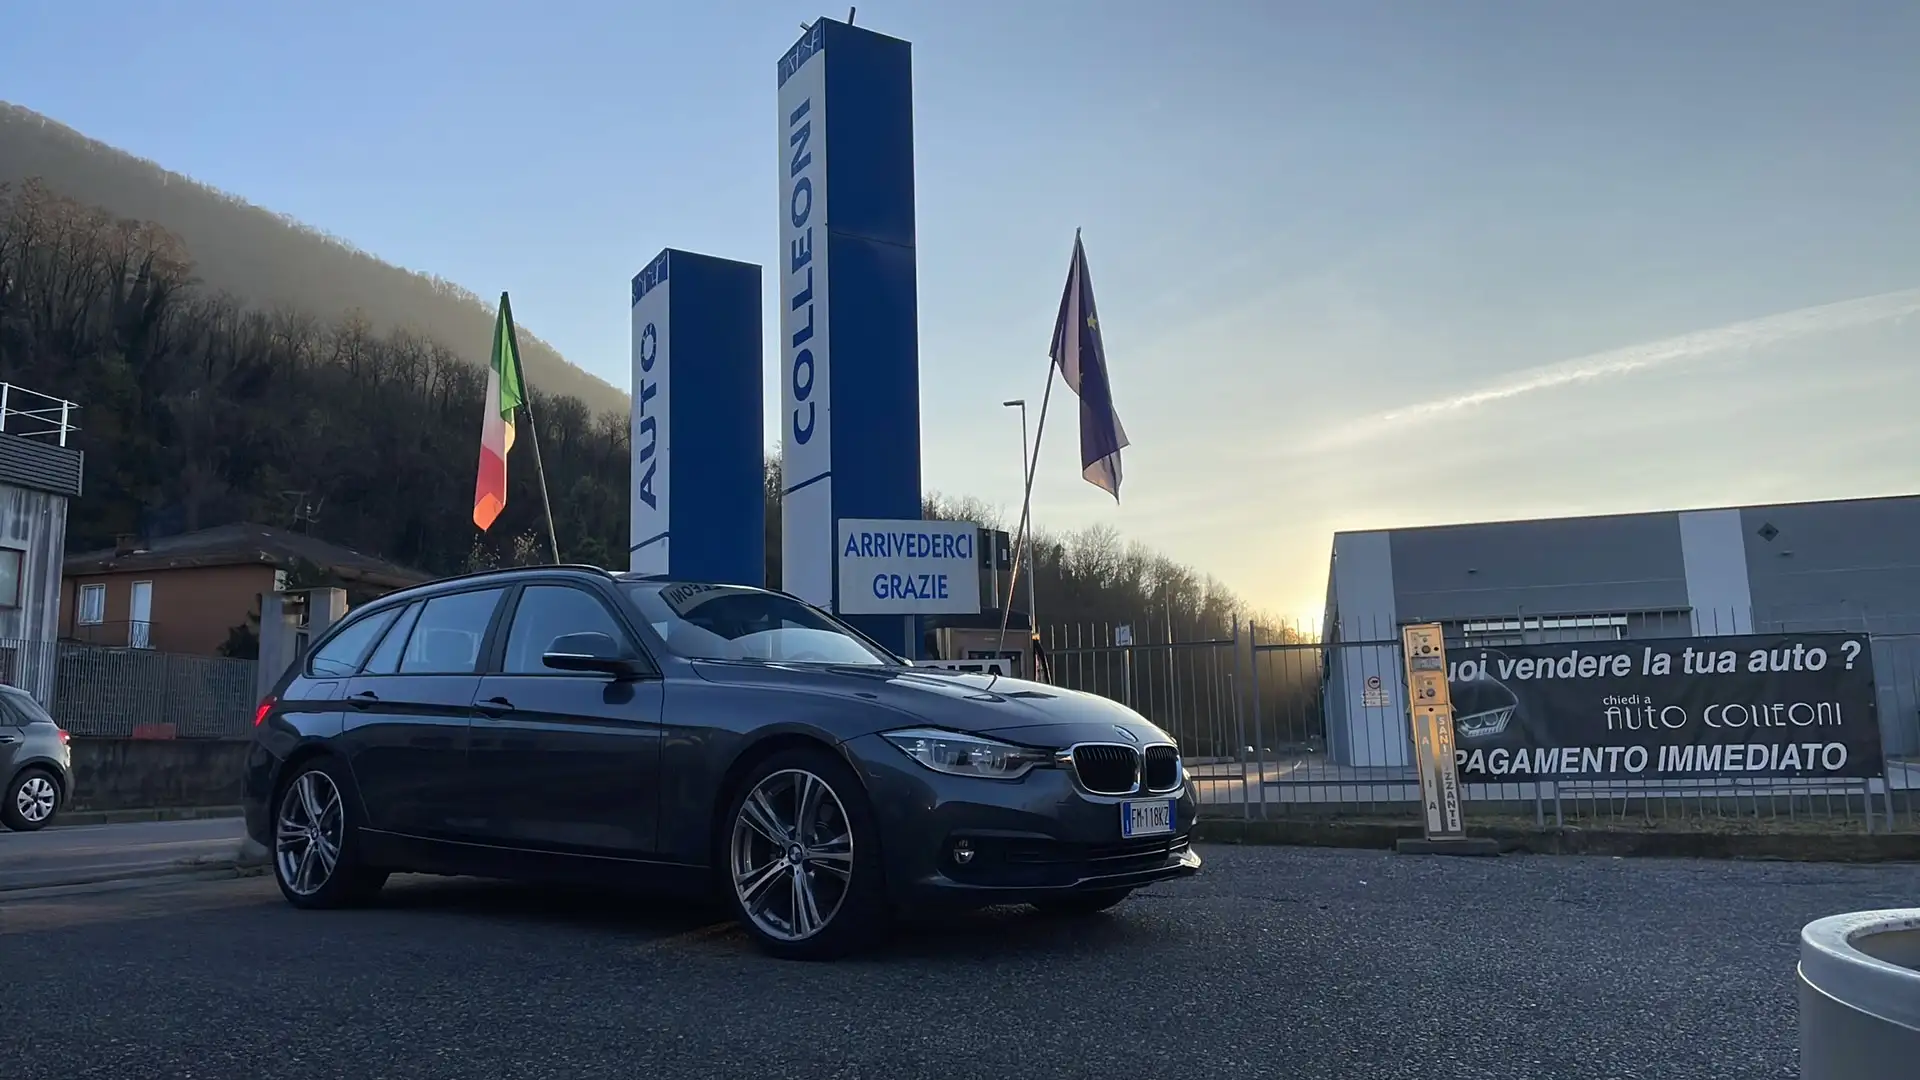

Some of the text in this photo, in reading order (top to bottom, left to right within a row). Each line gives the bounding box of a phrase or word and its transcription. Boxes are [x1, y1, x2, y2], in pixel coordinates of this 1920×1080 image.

[791, 97, 814, 444] COLLEONI
[640, 322, 657, 511] AUTO
[844, 532, 972, 558] ARRIVEDERCI
[873, 573, 949, 599] GRAZIE
[1499, 650, 1631, 681] vendere
[1643, 647, 1671, 676] la
[1683, 646, 1737, 675] tua
[1749, 643, 1827, 673] auto
[1841, 640, 1861, 670] ?
[1603, 694, 1652, 705] chiedi a
[1456, 742, 1848, 774] PAGAMENTO IMMEDIATO
